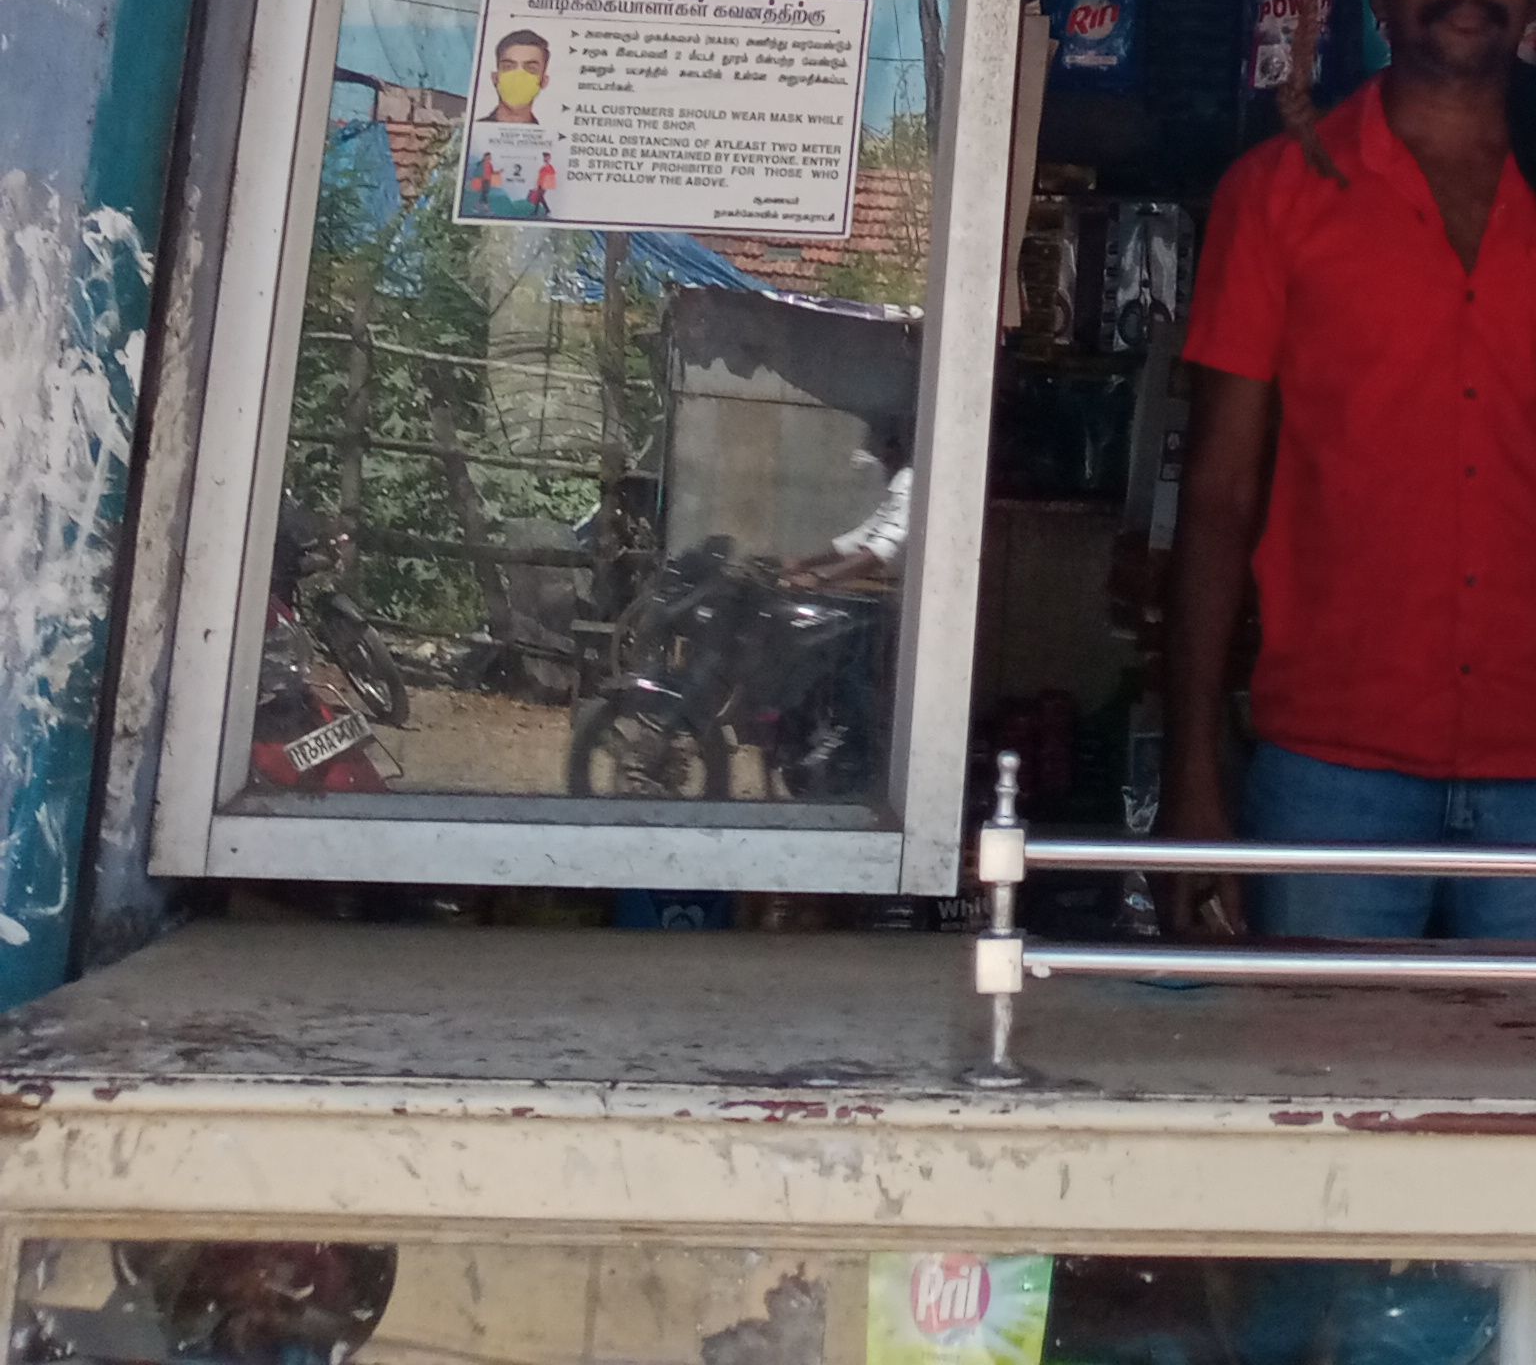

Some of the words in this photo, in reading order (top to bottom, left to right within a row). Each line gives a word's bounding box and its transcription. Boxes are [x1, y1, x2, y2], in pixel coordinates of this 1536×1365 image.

[1066, 0, 1121, 41] Rin
[573, 116, 633, 128] ENTERING
[637, 118, 659, 130] THE
[575, 103, 598, 115] ALL
[601, 105, 675, 118] CUSTOMERS
[678, 108, 727, 121] SHOULD
[731, 111, 767, 123] WEAR
[769, 112, 804, 124] MASK
[807, 114, 844, 127] WHILE
[571, 132, 614, 145] SOCIAL
[619, 135, 690, 148] DISTANCING
[694, 138, 711, 149] OF
[714, 139, 767, 151] ATLEAST
[771, 141, 798, 153] TWO
[801, 143, 842, 155] METER
[570, 145, 618, 157] SHOULD
[621, 147, 638, 159] BE
[640, 149, 711, 162] MAINTAINED
[714, 152, 730, 163] BY
[801, 155, 841, 168] ENTRY
[567, 170, 603, 182] DON'T
[605, 172, 656, 184] FOLLOW
[659, 175, 682, 186] THE
[685, 176, 729, 188] ABOVE.
[568, 158, 580, 168] IS
[588, 159, 644, 171] STRICTLY
[651, 162, 723, 175] PROHIBITED
[731, 166, 756, 176] FOR
[764, 167, 803, 179] THOSE
[811, 168, 840, 181] WHO
[915, 1263, 982, 1322] Pril
